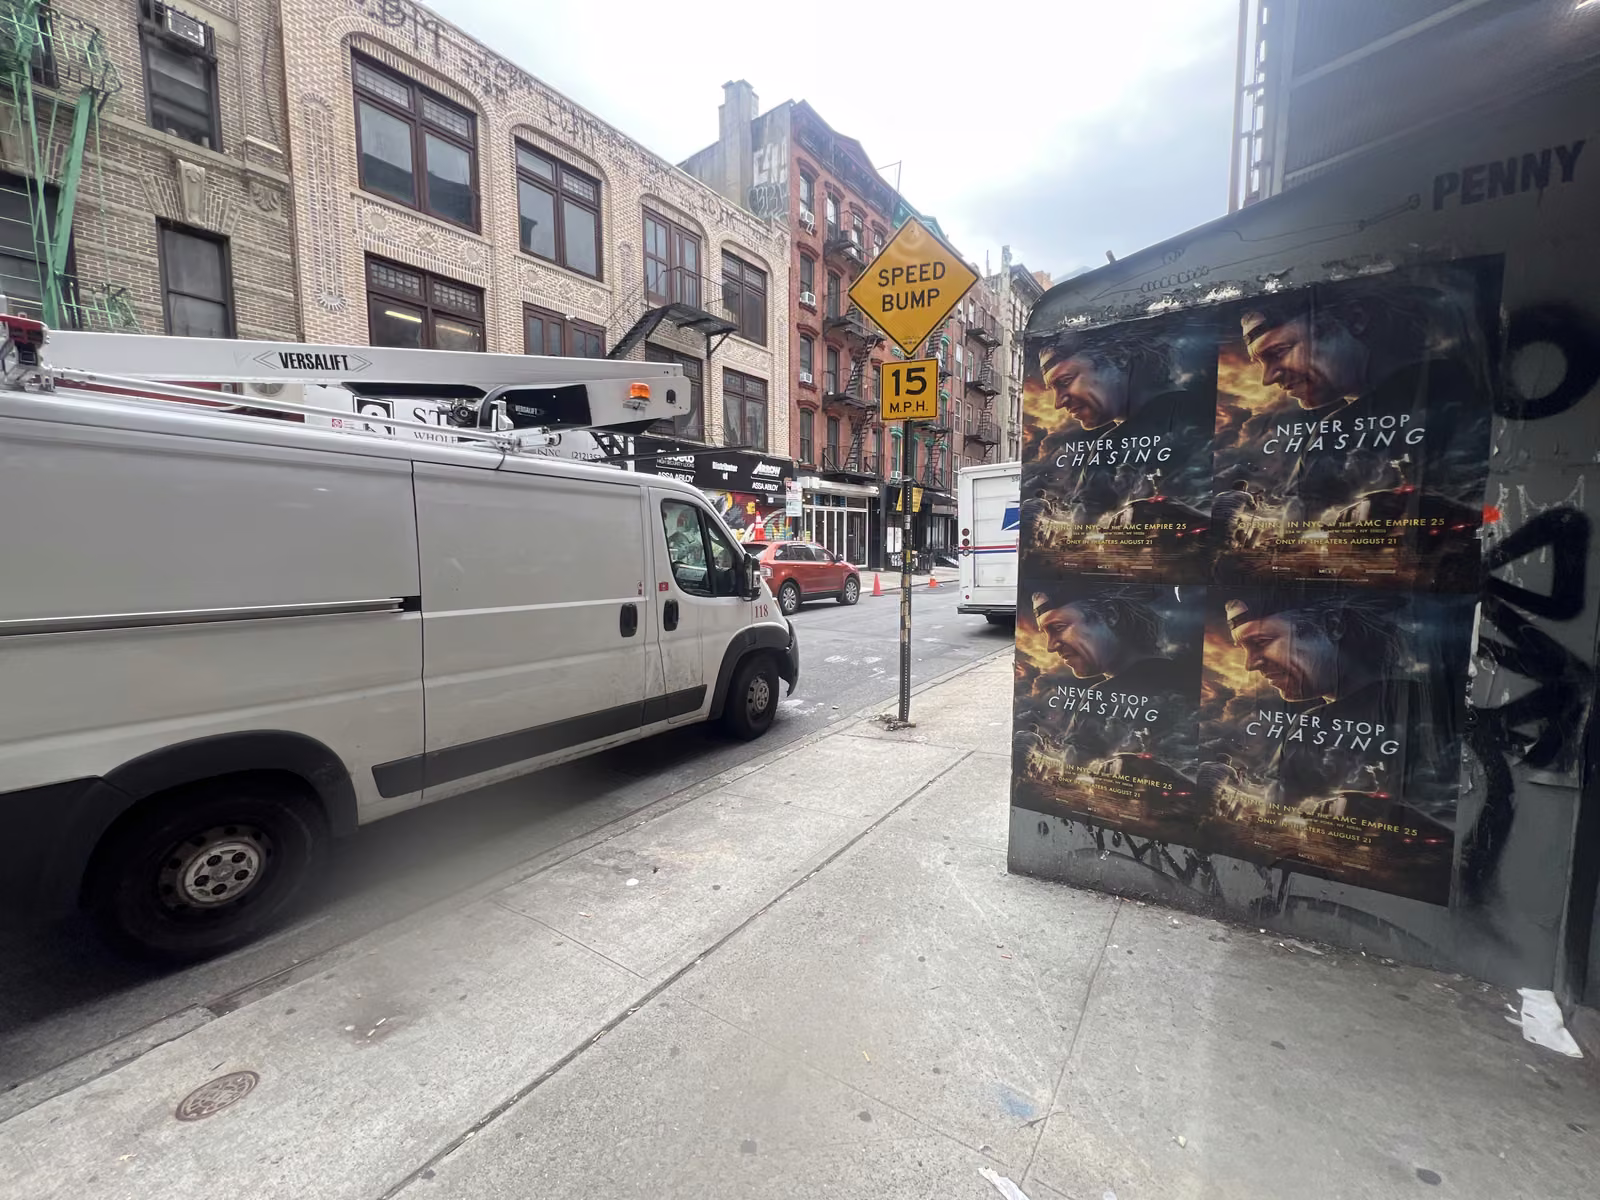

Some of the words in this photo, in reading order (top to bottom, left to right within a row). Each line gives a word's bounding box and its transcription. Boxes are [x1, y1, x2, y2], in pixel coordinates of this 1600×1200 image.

[1432, 139, 1586, 211] PENNY
[877, 262, 946, 287] SPEED
[881, 288, 940, 313] BUMP
[278, 351, 349, 371] VERSALIFT
[891, 366, 927, 397] 15
[889, 401, 929, 414] M.P.H.
[1277, 420, 1342, 437] NEVER
[1354, 414, 1411, 431] STOP
[1065, 439, 1113, 453] NEVER
[1121, 435, 1161, 449] STOP
[1263, 428, 1426, 455] CHASING
[1056, 447, 1172, 468] CHASING
[752, 481, 764, 489] ASSA
[764, 483, 779, 491] ABLOY
[1287, 520, 1299, 528] IN
[1302, 520, 1324, 528] NYC
[1355, 519, 1381, 527] AMC
[1385, 518, 1426, 527] EMPIRE
[1430, 518, 1445, 526] 25
[755, 604, 769, 618] 118
[1057, 685, 1103, 701] NEVER
[1110, 692, 1149, 707] STOP
[1048, 696, 1159, 722] CHASING
[1259, 709, 1321, 728] NEVER
[1331, 718, 1385, 737] STOP
[1246, 721, 1400, 755] CHASING
[1109, 787, 1132, 796] AUGUST
[1112, 774, 1130, 782] AMC
[1132, 777, 1160, 788] EMPIRE
[1257, 816, 1277, 825] ONLY
[1328, 831, 1360, 841] AUGUST
[1269, 802, 1280, 811] IN
[1332, 815, 1357, 825] AMC
[1361, 819, 1400, 833] EMPIRE
[1403, 827, 1418, 837] 25
